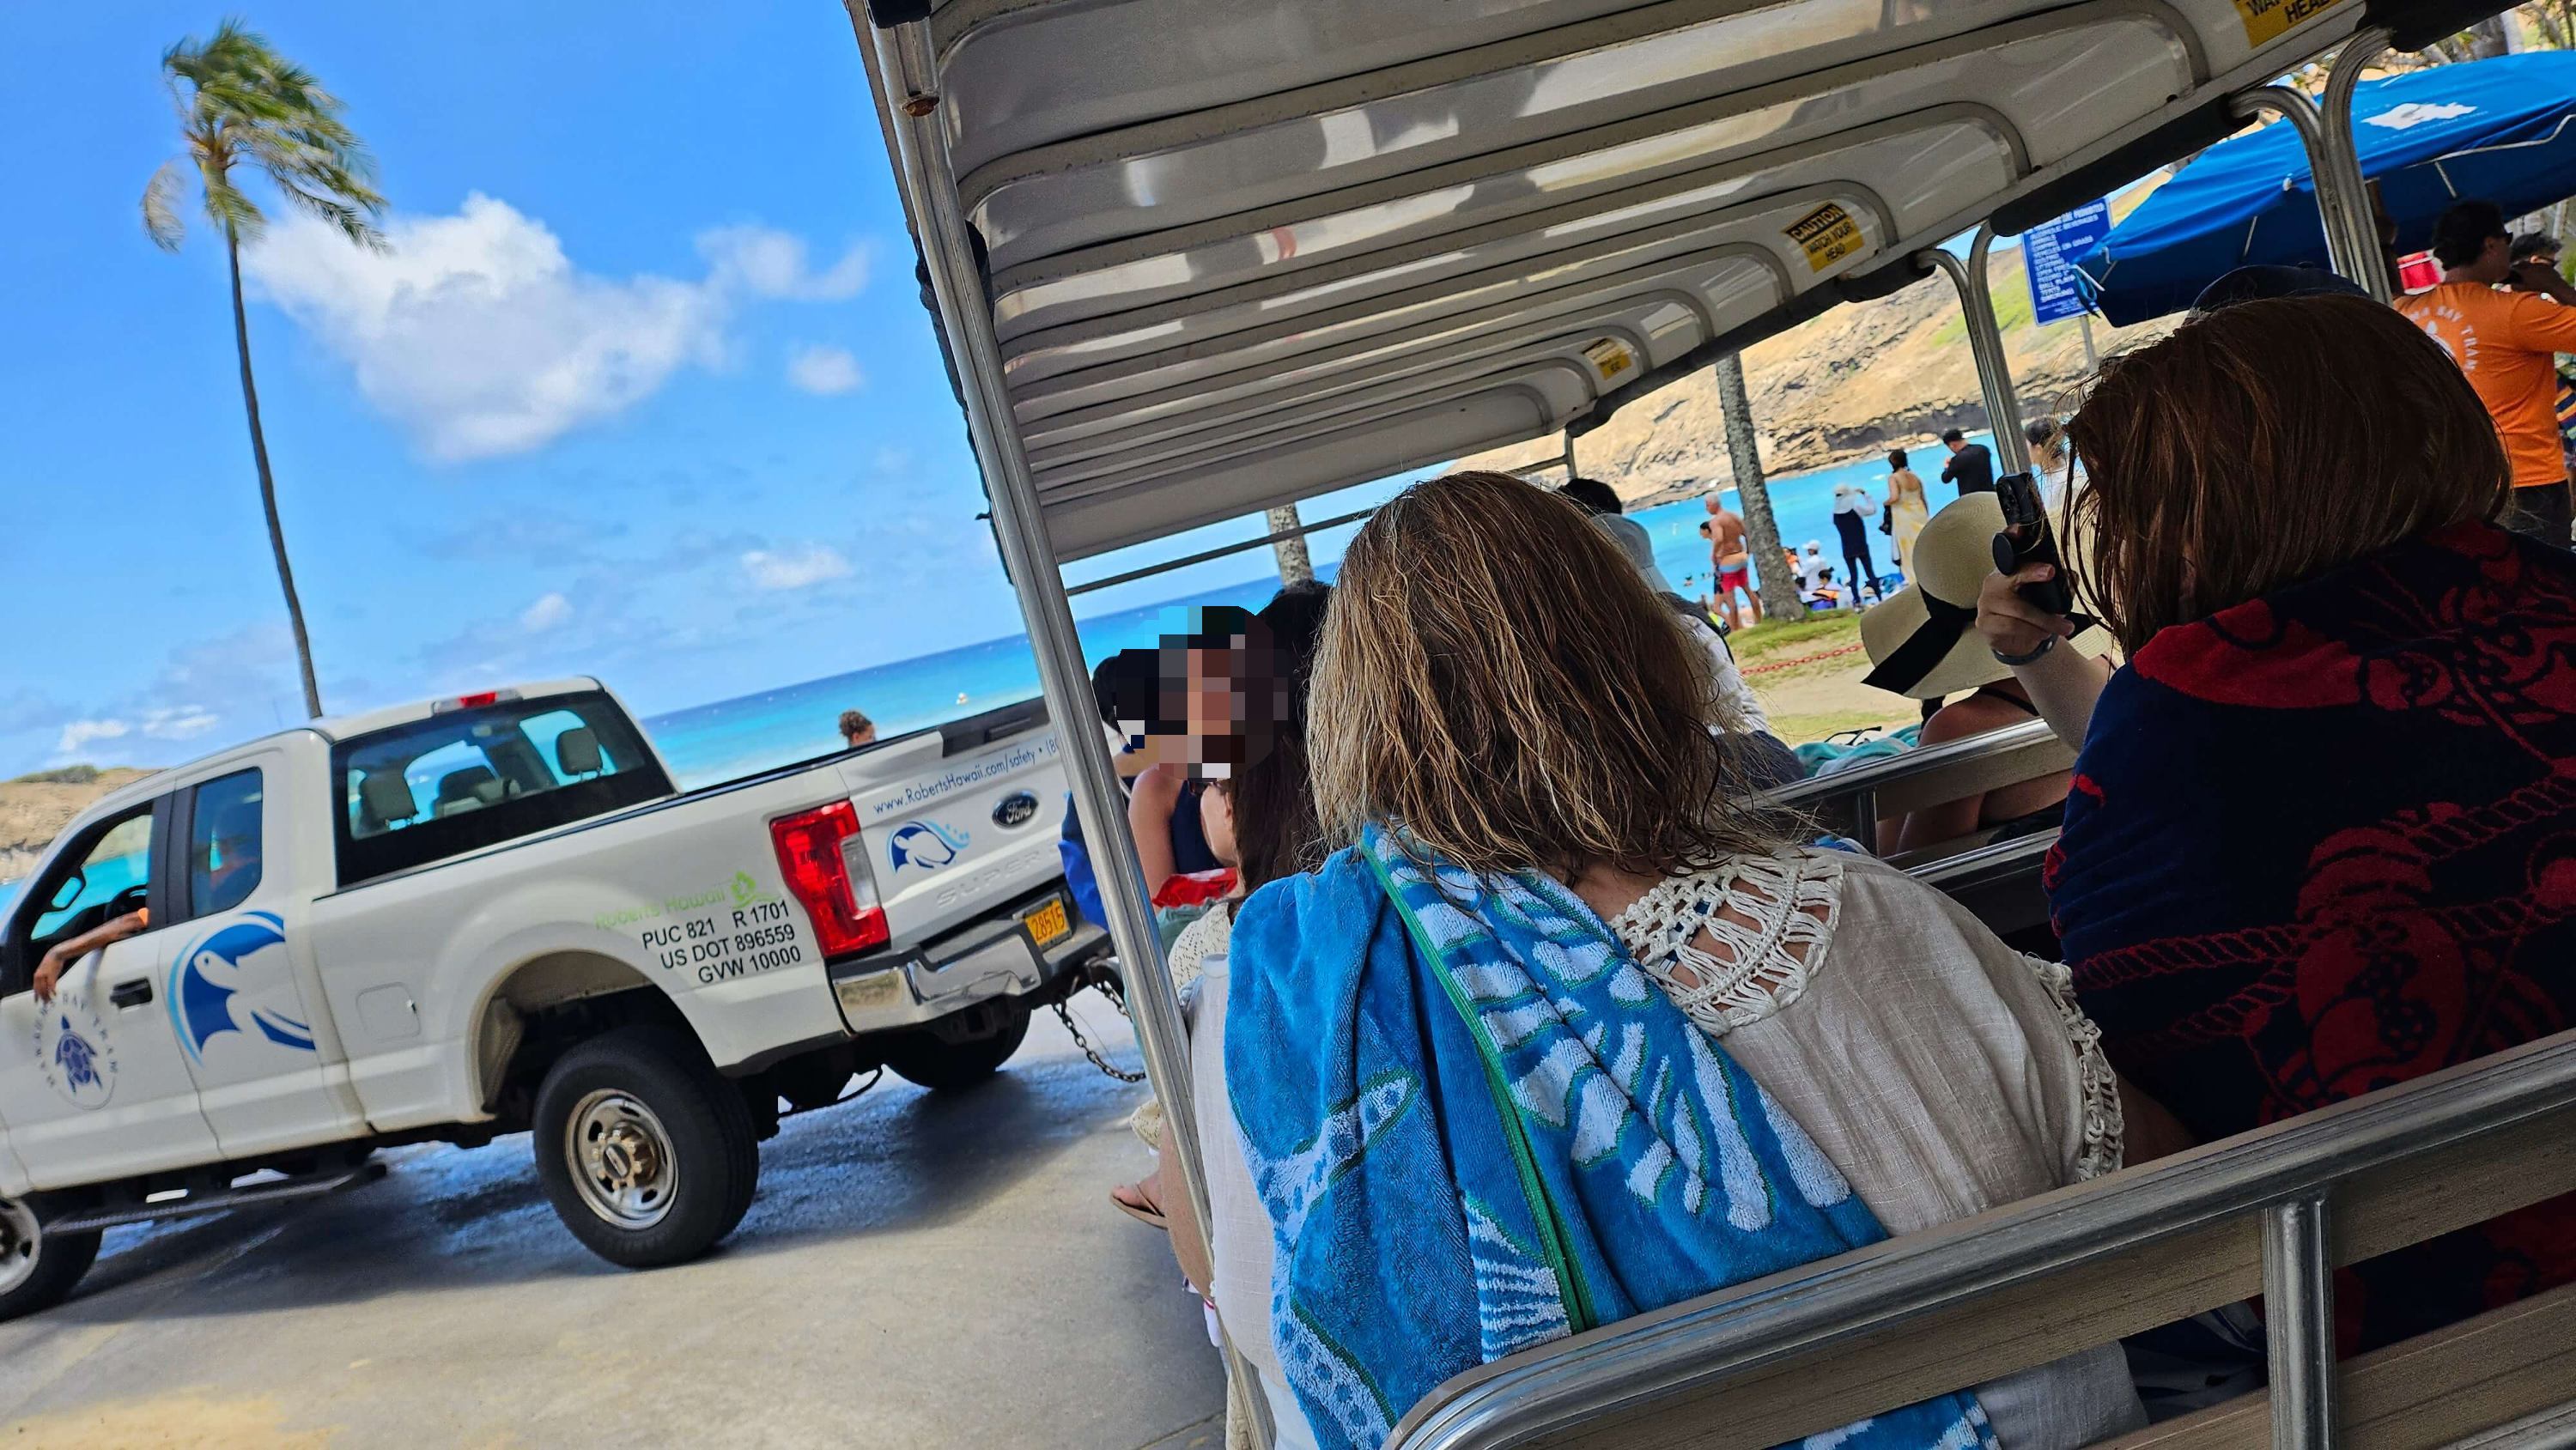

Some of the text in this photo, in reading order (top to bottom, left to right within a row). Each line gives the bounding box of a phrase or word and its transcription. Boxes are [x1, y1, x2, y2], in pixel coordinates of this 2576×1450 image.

[1790, 205, 1844, 240] CAUTION
[872, 748, 1036, 815] www.RobertsHawaii.com/safety
[1005, 799, 1033, 824] Ford
[937, 850, 1042, 908] SUPER
[594, 888, 726, 930] Roberts Hawaii
[641, 899, 790, 950] PUC 821 R 1701
[1030, 906, 1066, 942] 28515
[660, 923, 795, 970] US DOT 896559
[698, 945, 801, 984] GVW 10000
